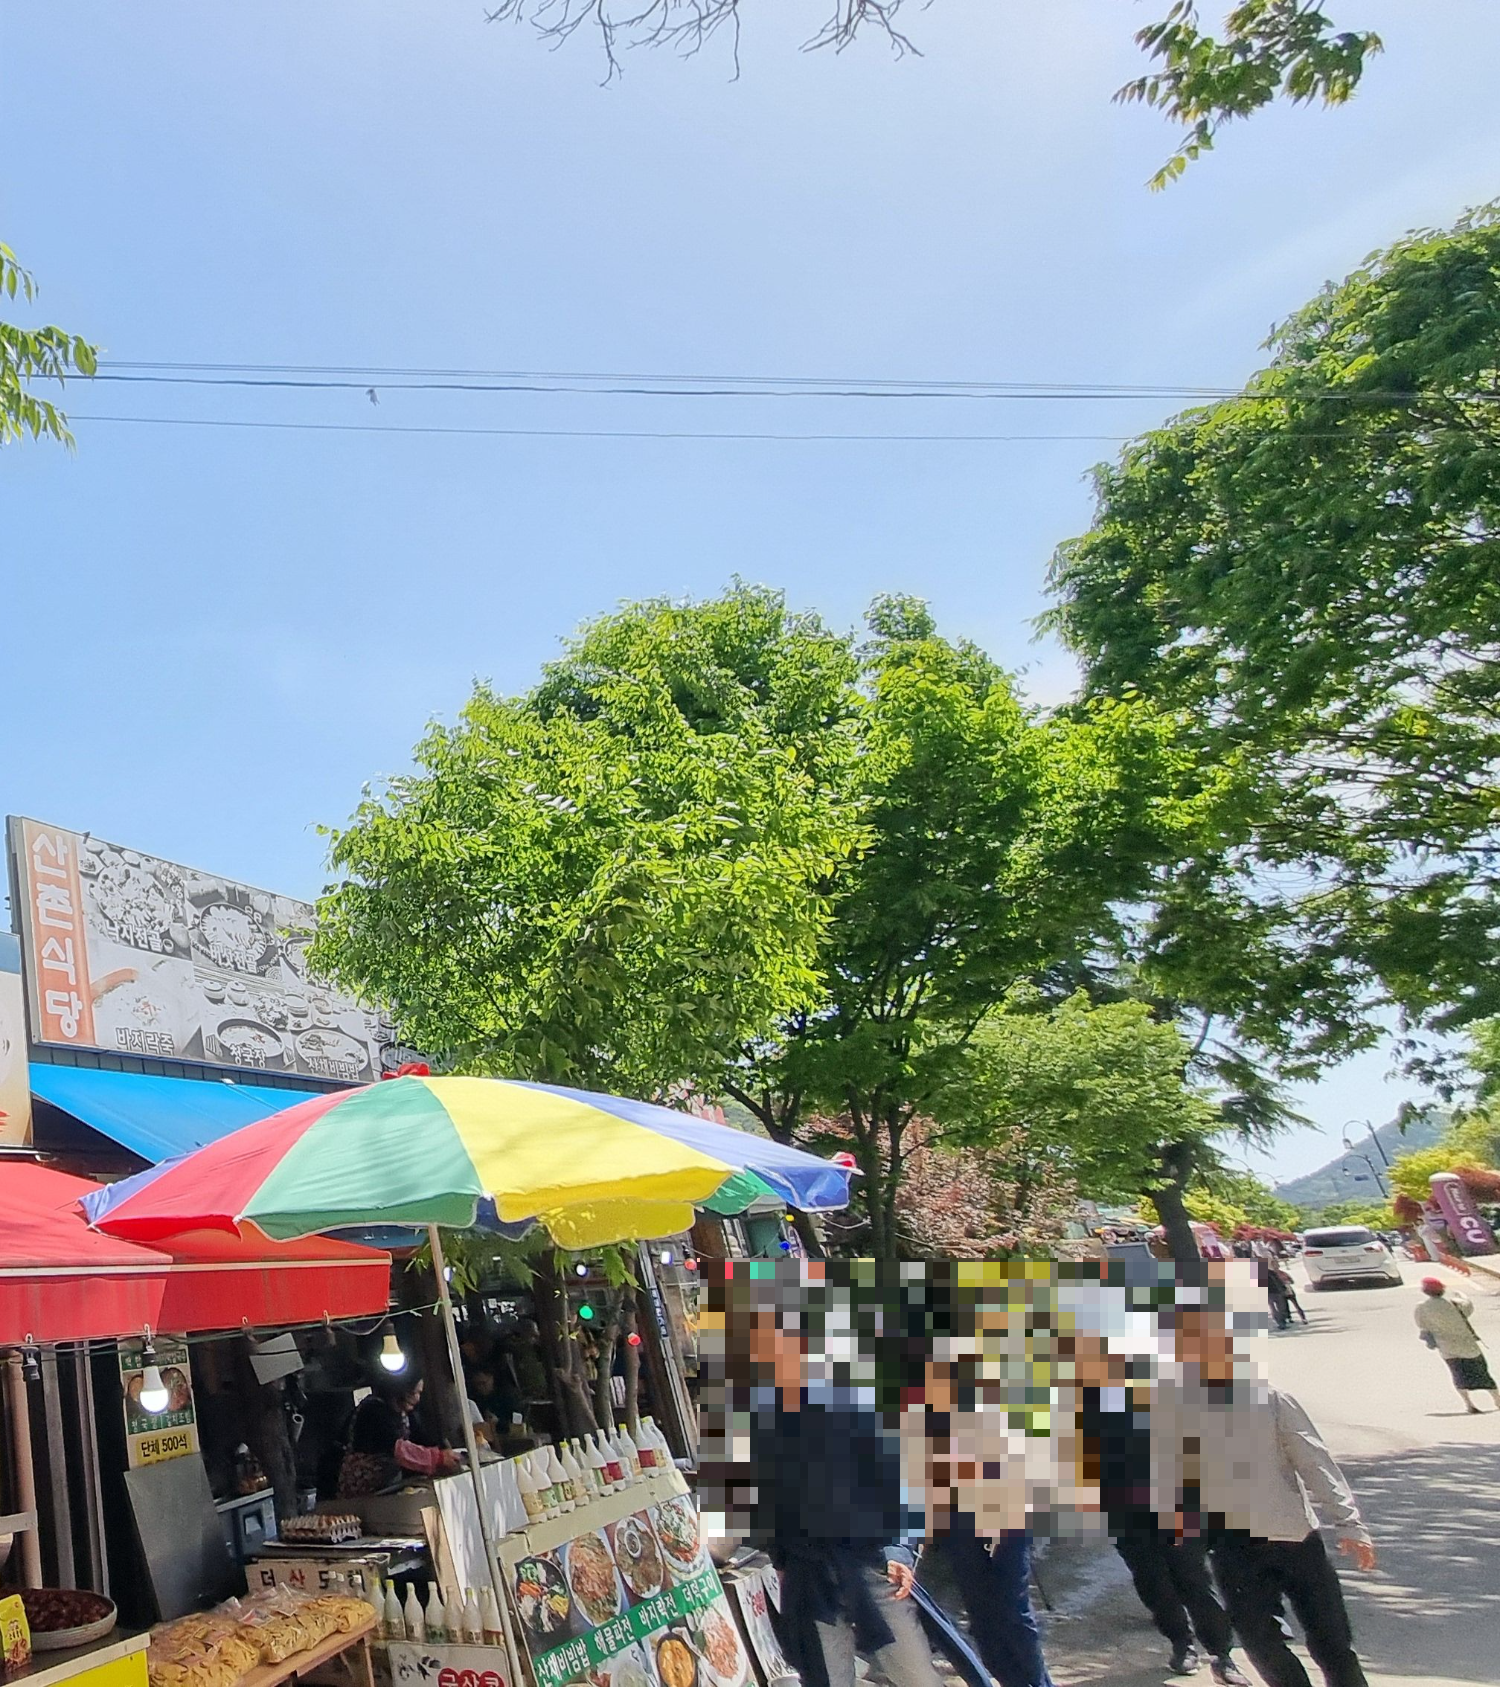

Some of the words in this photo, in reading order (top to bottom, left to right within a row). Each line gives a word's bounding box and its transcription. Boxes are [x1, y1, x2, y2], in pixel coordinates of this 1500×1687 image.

[32, 833, 83, 1038] 산촌식당
[106, 919, 163, 953] 낙지전골
[115, 1026, 175, 1056] 바지락죽
[1460, 1217, 1487, 1243] CU
[141, 1439, 161, 1458] 단체
[161, 1433, 188, 1453] 500석
[637, 1591, 680, 1631] 바지락전
